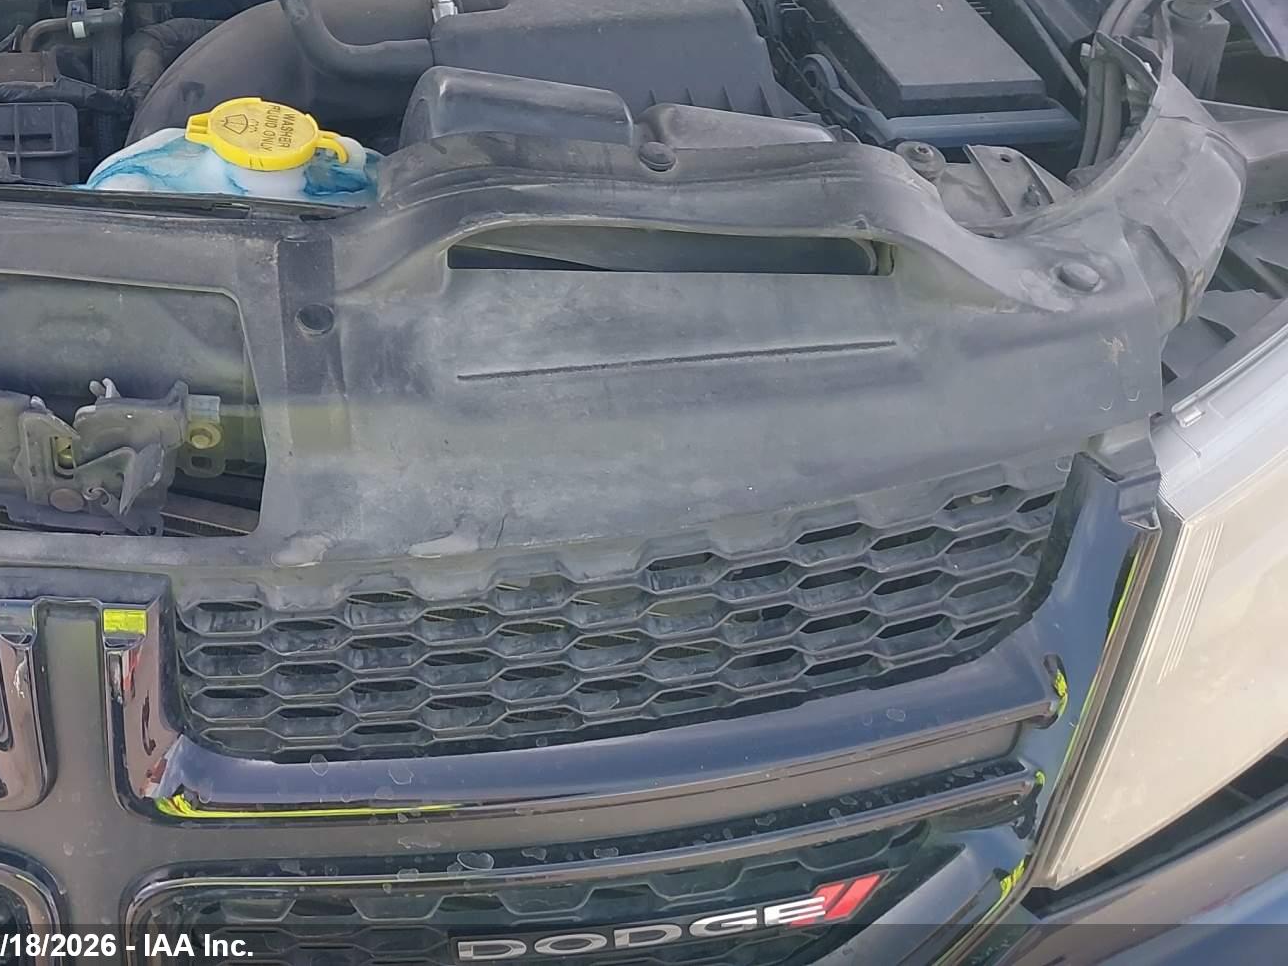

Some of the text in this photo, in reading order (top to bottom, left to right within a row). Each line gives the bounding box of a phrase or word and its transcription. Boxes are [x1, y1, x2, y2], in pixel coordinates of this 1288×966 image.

[260, 104, 281, 152] FLUID ONLY
[279, 113, 296, 148] WASHER
[457, 895, 826, 961] DODGE
